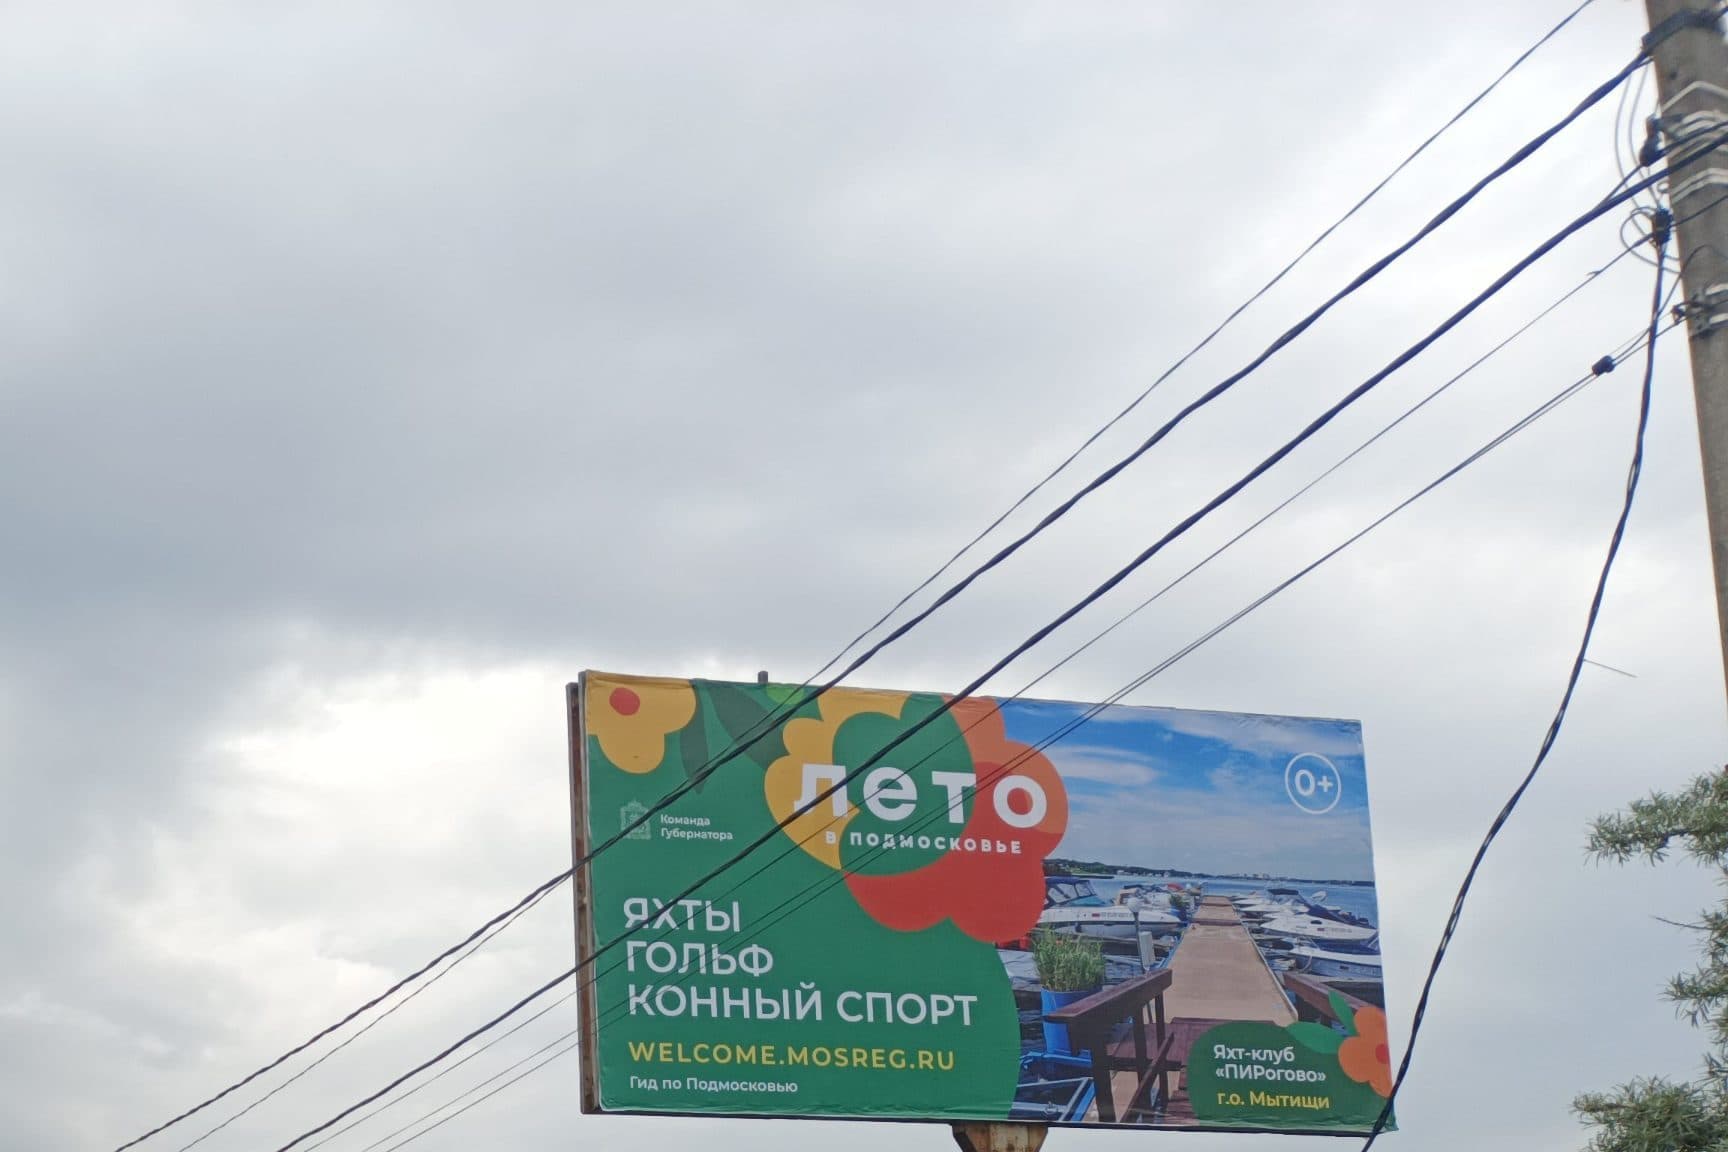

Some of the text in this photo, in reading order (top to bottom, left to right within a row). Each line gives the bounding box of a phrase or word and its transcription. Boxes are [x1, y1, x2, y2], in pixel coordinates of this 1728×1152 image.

[1294, 768, 1334, 797] 0+
[660, 814, 711, 827] Команда
[661, 827, 734, 842] Губернатора
[623, 897, 741, 933] ЯХТЫ
[626, 940, 774, 977] ГОЛЬФ
[628, 981, 978, 1026] КОННЫЙ СПОРТ
[628, 1041, 956, 1071] WELCOME.MOSREG.RU
[1213, 1044, 1295, 1065] Яхт-клуб
[629, 1075, 799, 1094] Гид по Подмосковью
[1217, 1091, 1331, 1110] г.о. Мытищи
